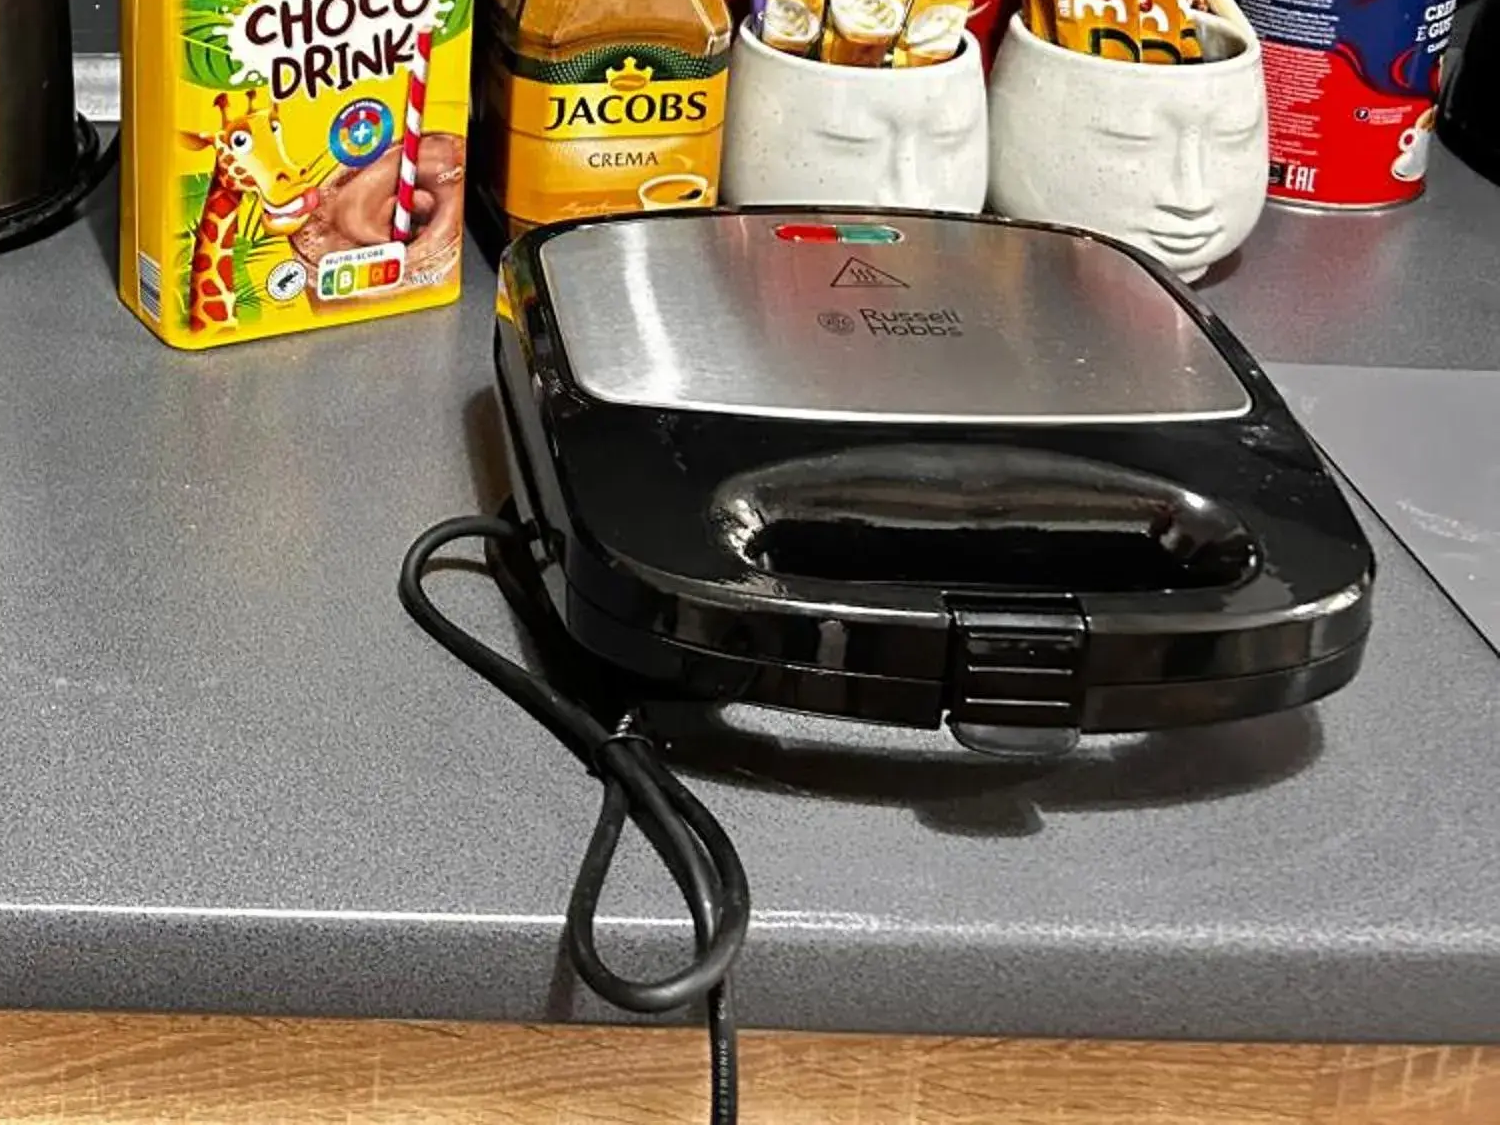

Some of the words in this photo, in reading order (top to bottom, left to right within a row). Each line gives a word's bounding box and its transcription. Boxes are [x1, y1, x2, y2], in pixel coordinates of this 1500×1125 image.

[271, 23, 415, 101] DRINK
[544, 90, 708, 131] JACOBS
[588, 151, 659, 169] CREMA
[325, 248, 386, 266] NUTRI-SCORE
[860, 308, 964, 324] Russell
[867, 322, 964, 337] Hobbs
